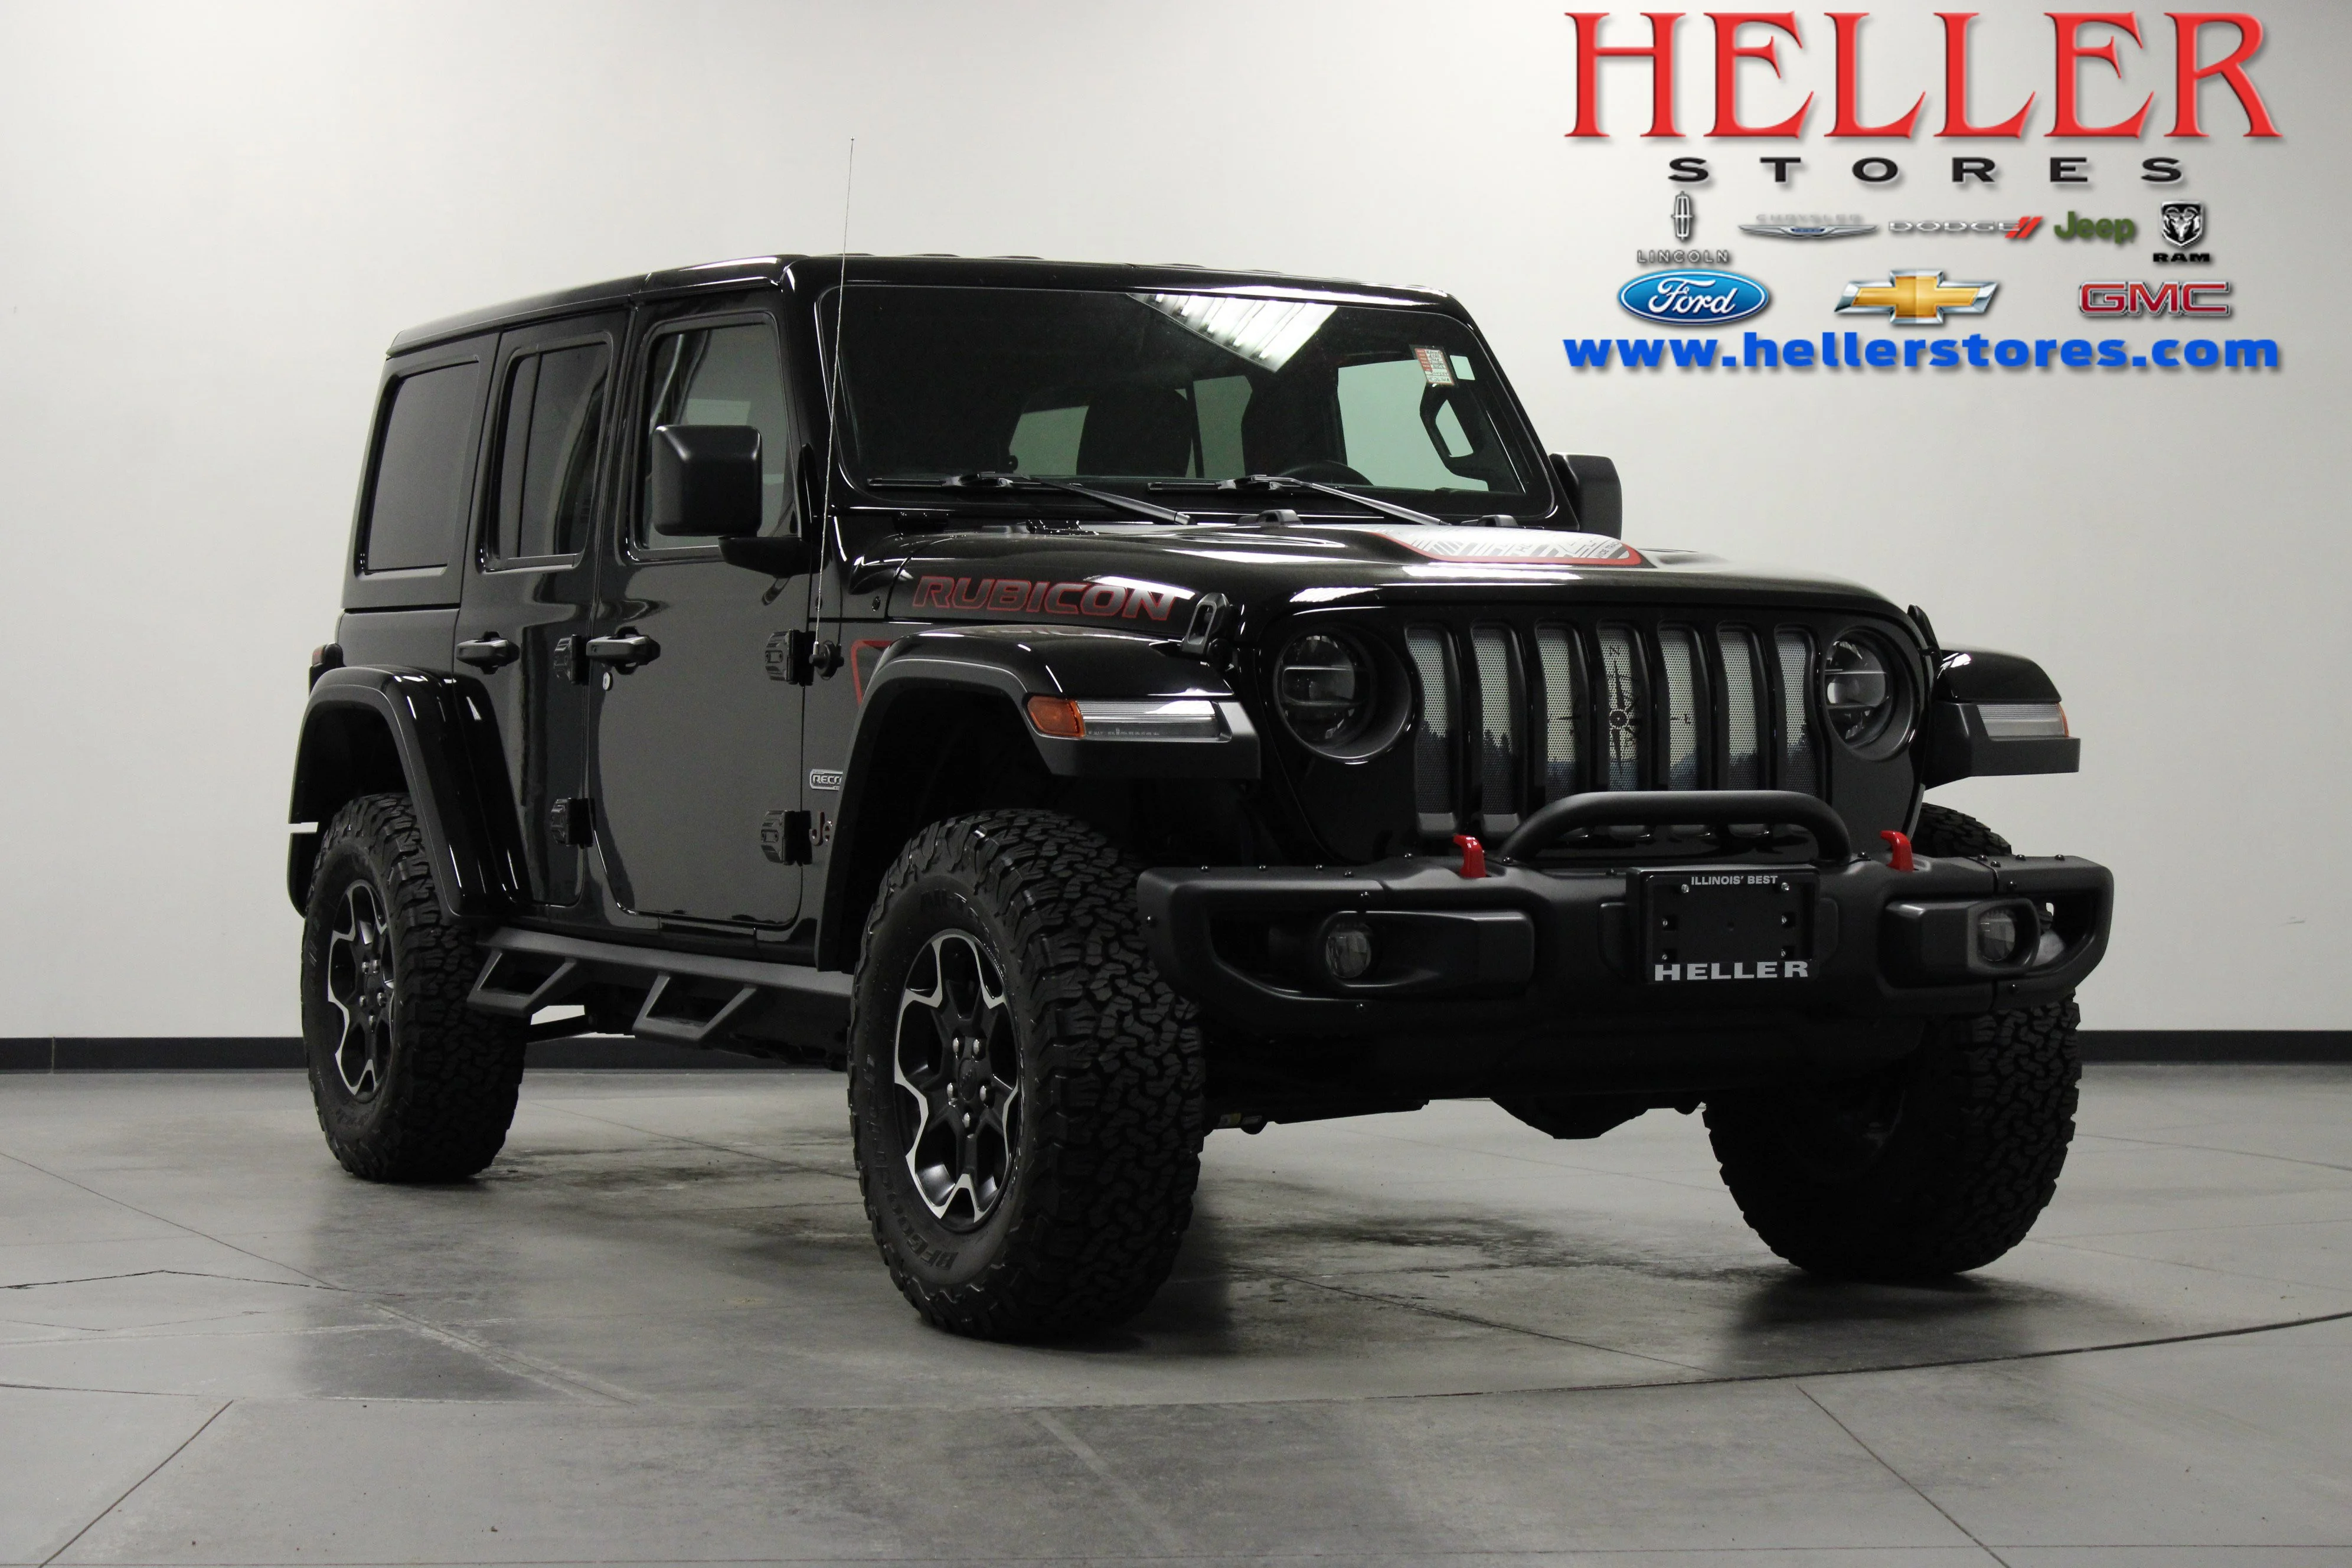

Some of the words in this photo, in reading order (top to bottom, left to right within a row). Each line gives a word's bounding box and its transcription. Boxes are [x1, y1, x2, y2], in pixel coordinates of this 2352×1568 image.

[913, 576, 1178, 620] RUBICON
[812, 775, 842, 785] RECO
[1747, 876, 1778, 884] BEST
[1655, 961, 1808, 981] HELLER
